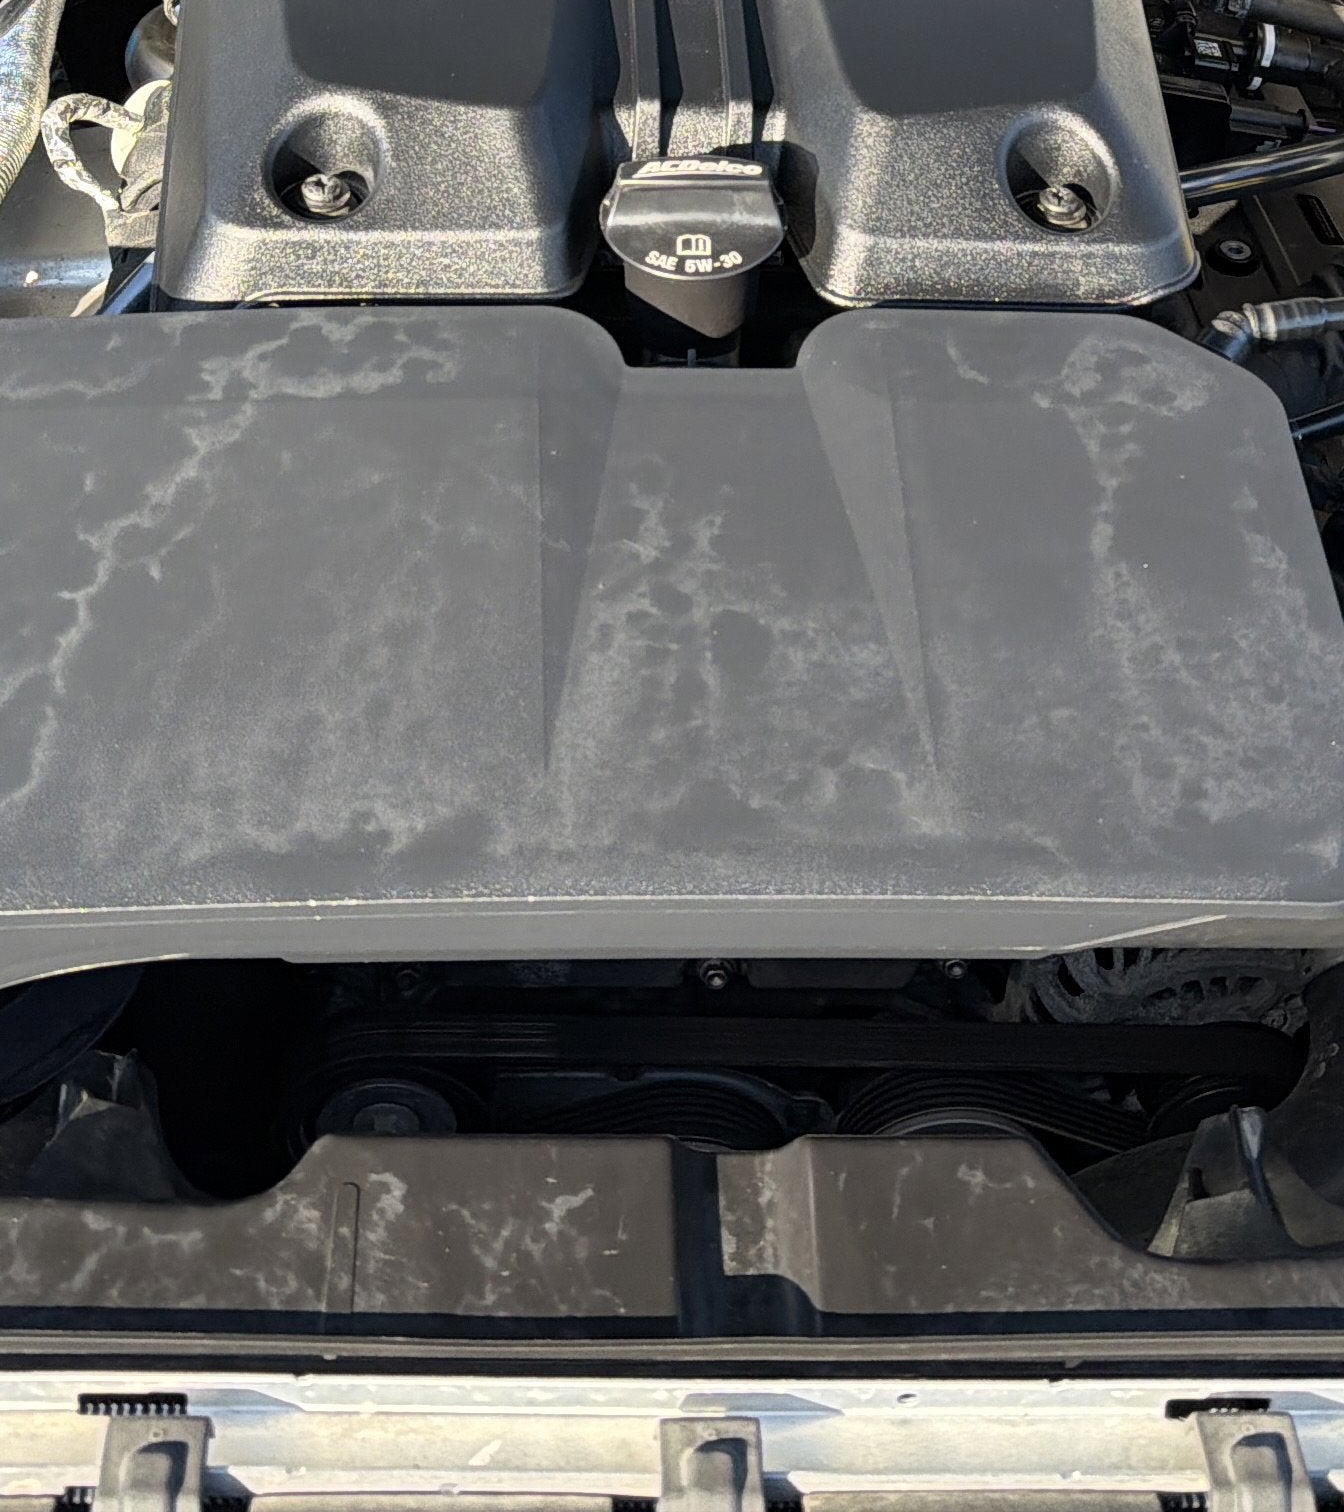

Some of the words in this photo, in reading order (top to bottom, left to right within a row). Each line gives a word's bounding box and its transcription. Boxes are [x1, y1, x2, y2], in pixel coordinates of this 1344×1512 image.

[637, 160, 763, 176] ACDelco
[645, 250, 679, 271] SAE
[684, 250, 743, 273] 5W-30
